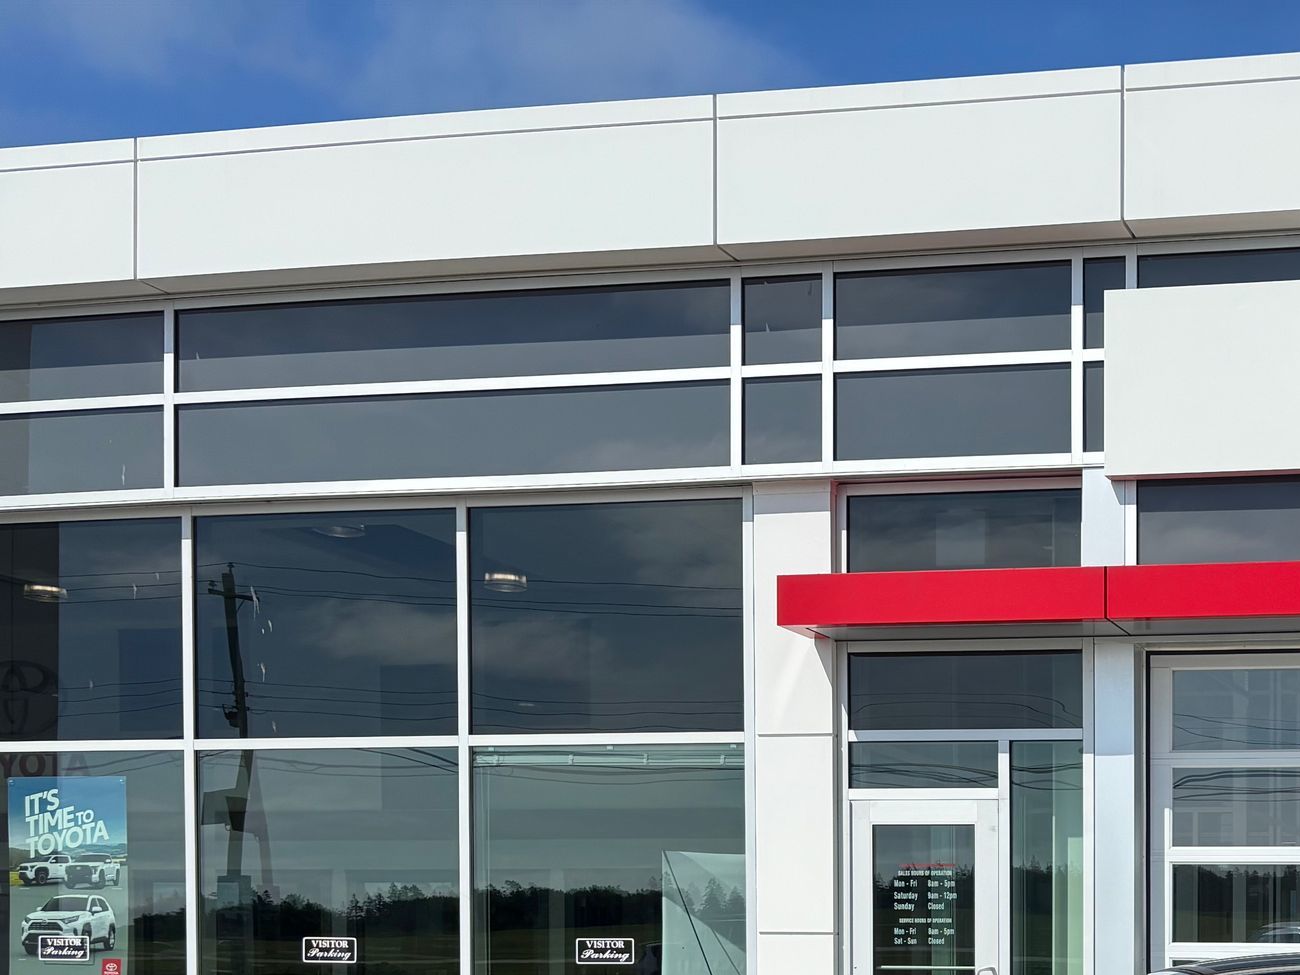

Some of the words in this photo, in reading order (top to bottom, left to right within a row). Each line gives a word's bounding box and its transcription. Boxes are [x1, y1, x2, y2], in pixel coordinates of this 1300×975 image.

[25, 789, 60, 816] IT'S
[25, 806, 75, 837] TIME
[75, 809, 94, 825] TO
[25, 820, 109, 858] TOYOTA
[893, 892, 918, 900] Saturday
[944, 892, 957, 900] 12pm
[893, 902, 915, 911] Sunday
[927, 902, 945, 910] Closed
[46, 938, 82, 946] VISITOR
[311, 939, 349, 948] VISITOR
[585, 940, 625, 949] VISITOR
[42, 946, 84, 958] Parking
[307, 948, 351, 960] Parking
[580, 949, 630, 962] Parking
